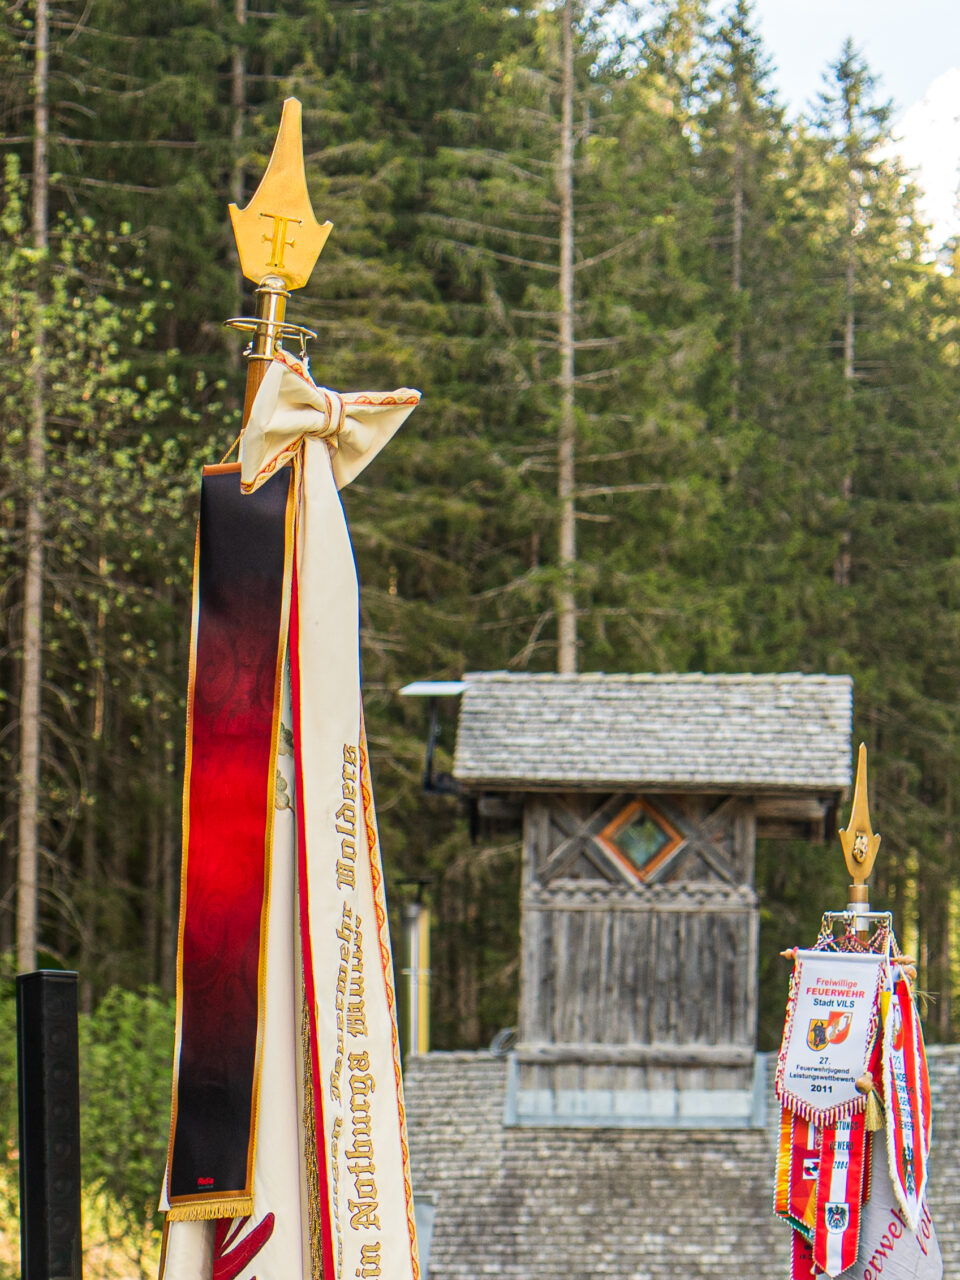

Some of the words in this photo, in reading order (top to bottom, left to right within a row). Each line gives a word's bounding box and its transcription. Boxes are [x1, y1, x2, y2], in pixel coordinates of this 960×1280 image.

[335, 743, 358, 891] Volders
[816, 977, 858, 988] Freiwillige
[806, 987, 865, 998] FEUERWEHR
[813, 998, 834, 1007] Stadt
[837, 999, 855, 1008] VILS
[795, 1064, 850, 1075] Feuerwehrjugend
[810, 1084, 833, 1094] 2011
[345, 1050, 381, 1231] Notburga
